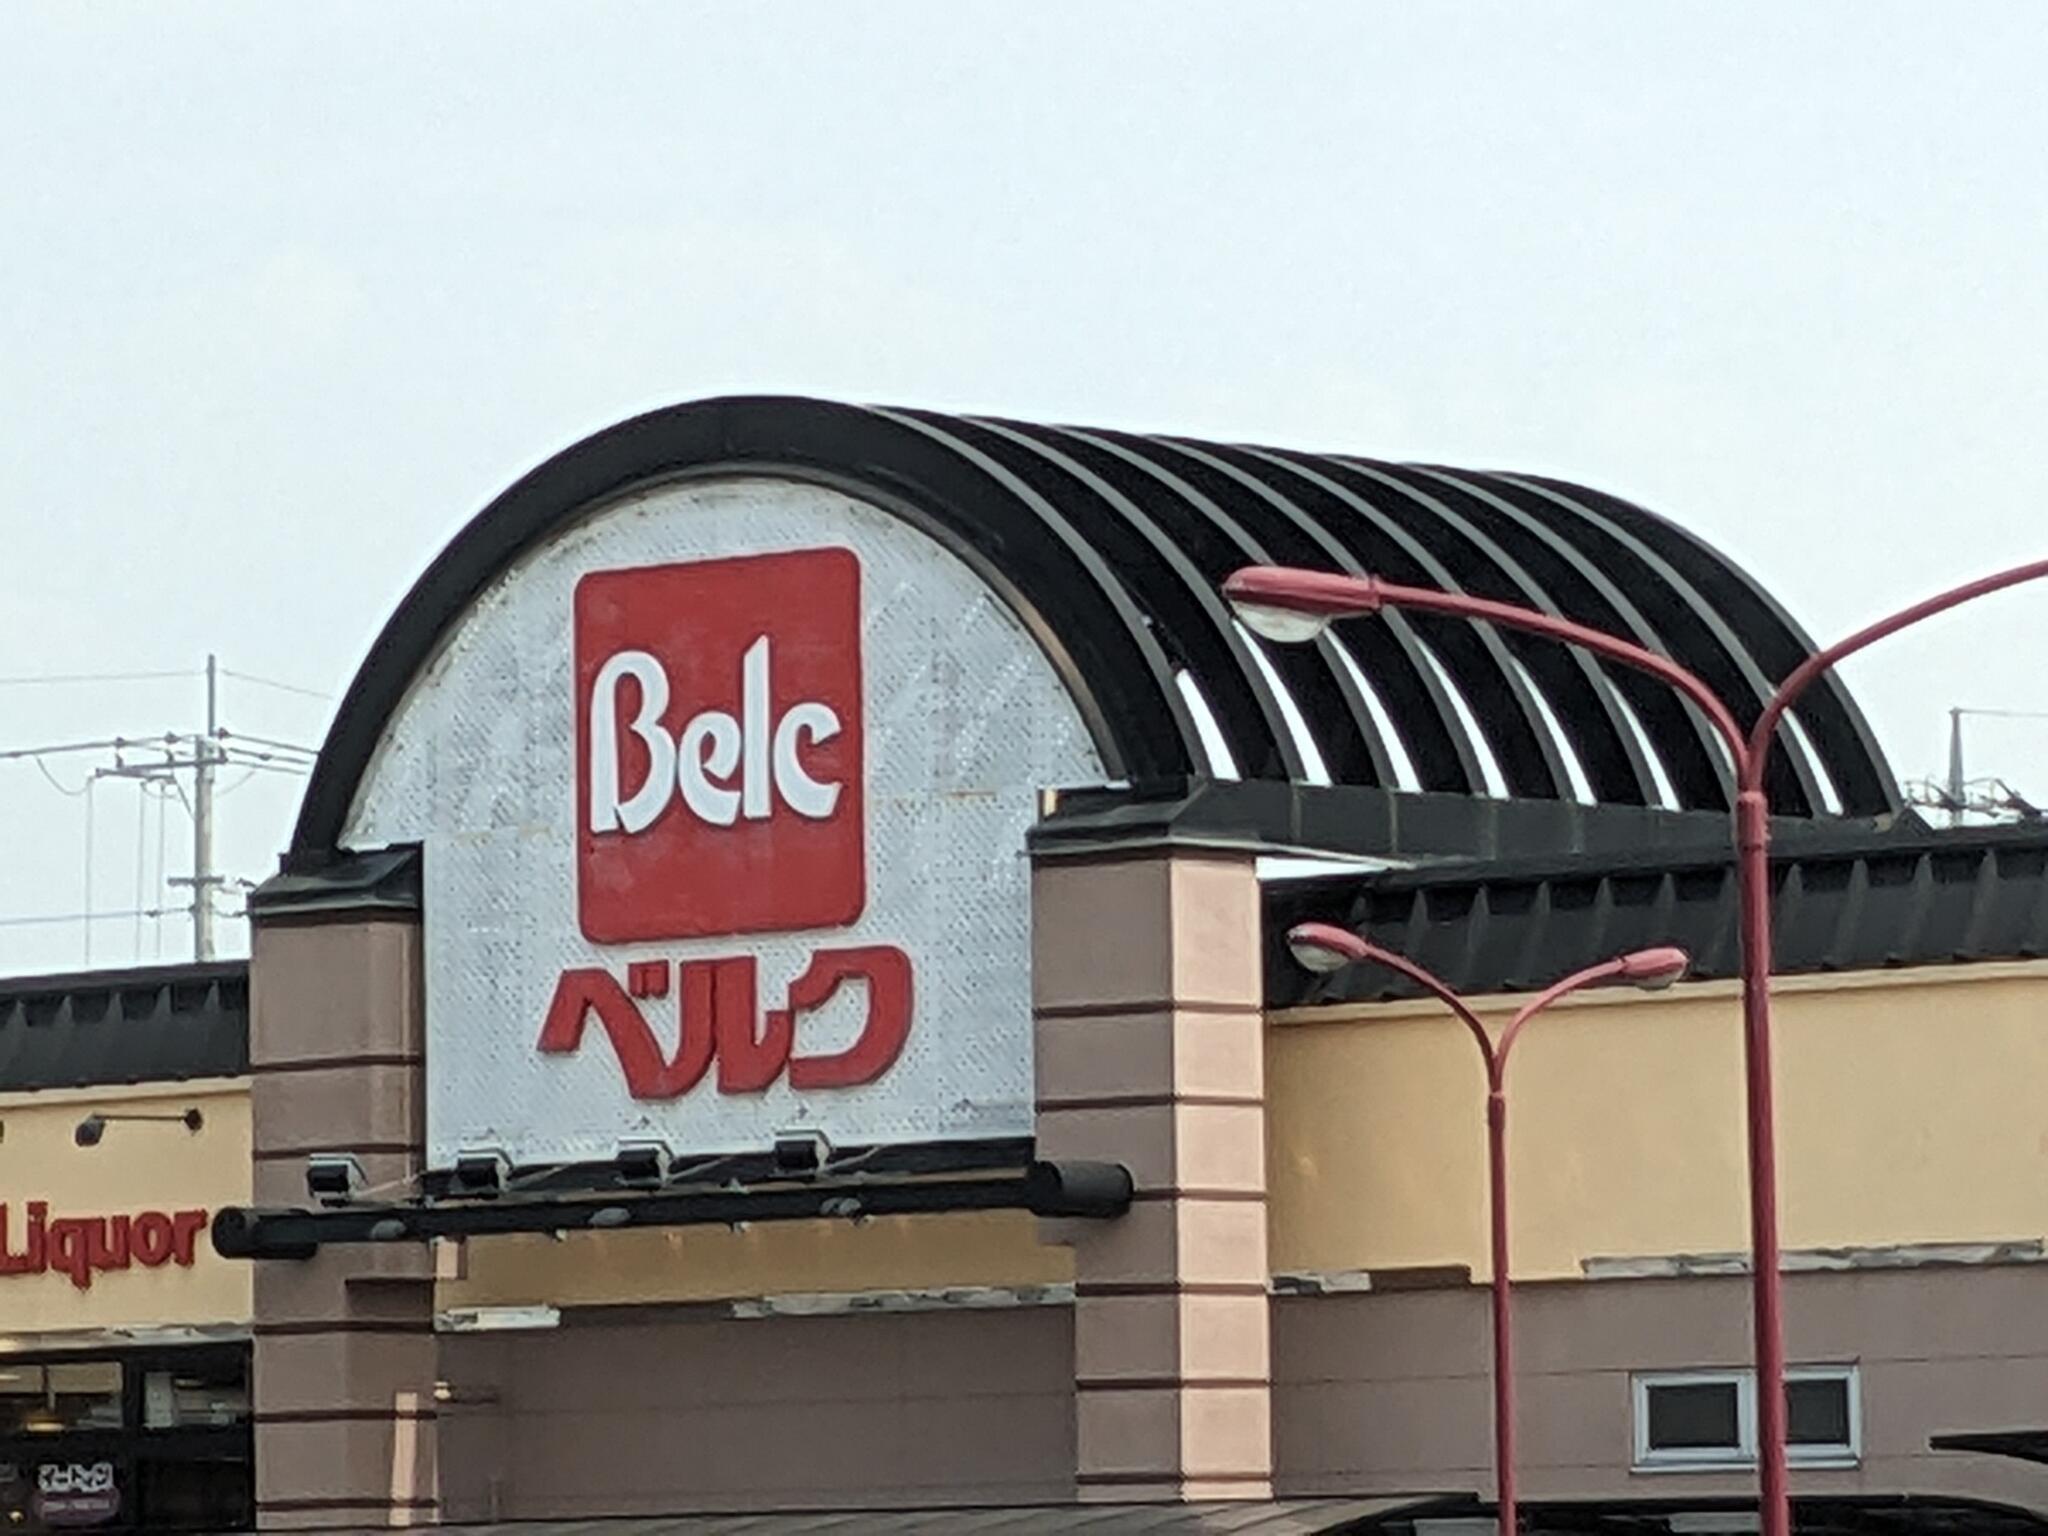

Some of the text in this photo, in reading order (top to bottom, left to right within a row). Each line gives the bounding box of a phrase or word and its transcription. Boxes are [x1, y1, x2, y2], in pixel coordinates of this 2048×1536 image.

[590, 634, 841, 834] Belc
[537, 945, 914, 1100] ベルク
[0, 1201, 207, 1290] Liquor
